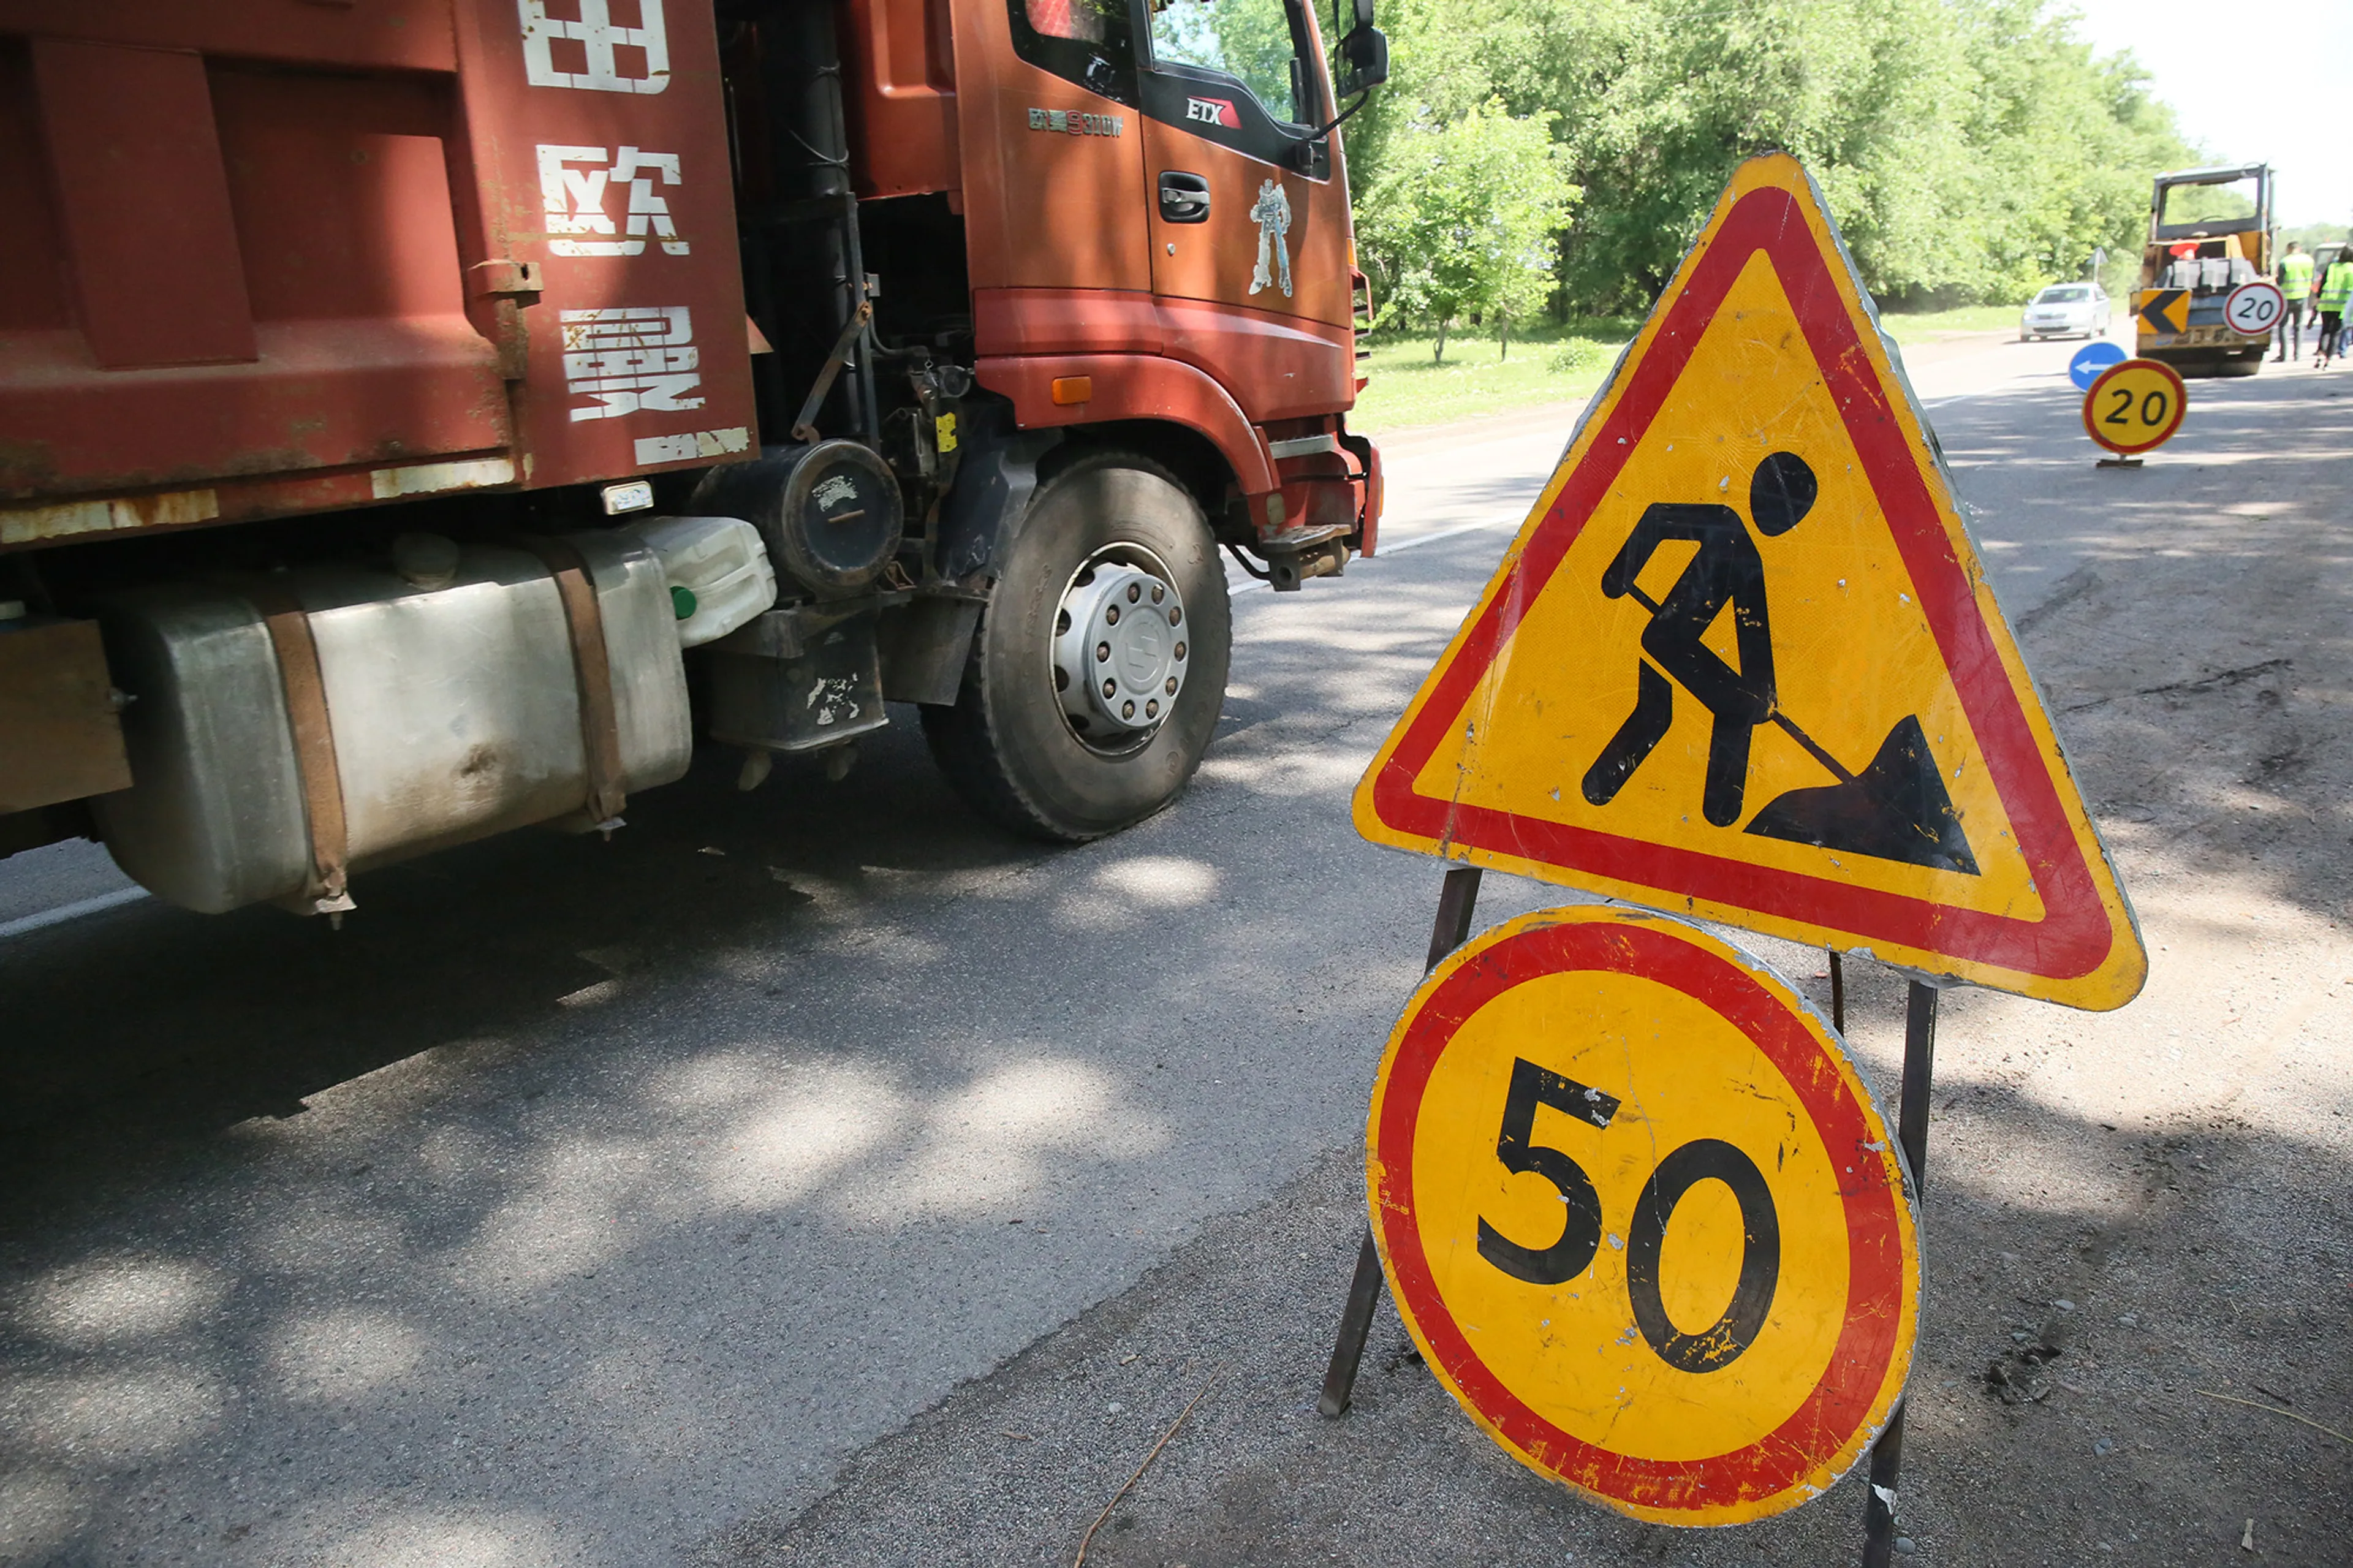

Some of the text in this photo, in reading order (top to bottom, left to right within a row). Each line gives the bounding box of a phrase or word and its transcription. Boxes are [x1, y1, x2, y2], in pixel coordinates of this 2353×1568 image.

[1186, 97, 1224, 126] ETX
[2238, 298, 2274, 321] 20
[2105, 388, 2167, 426] 20
[1477, 1056, 1780, 1374] 50
